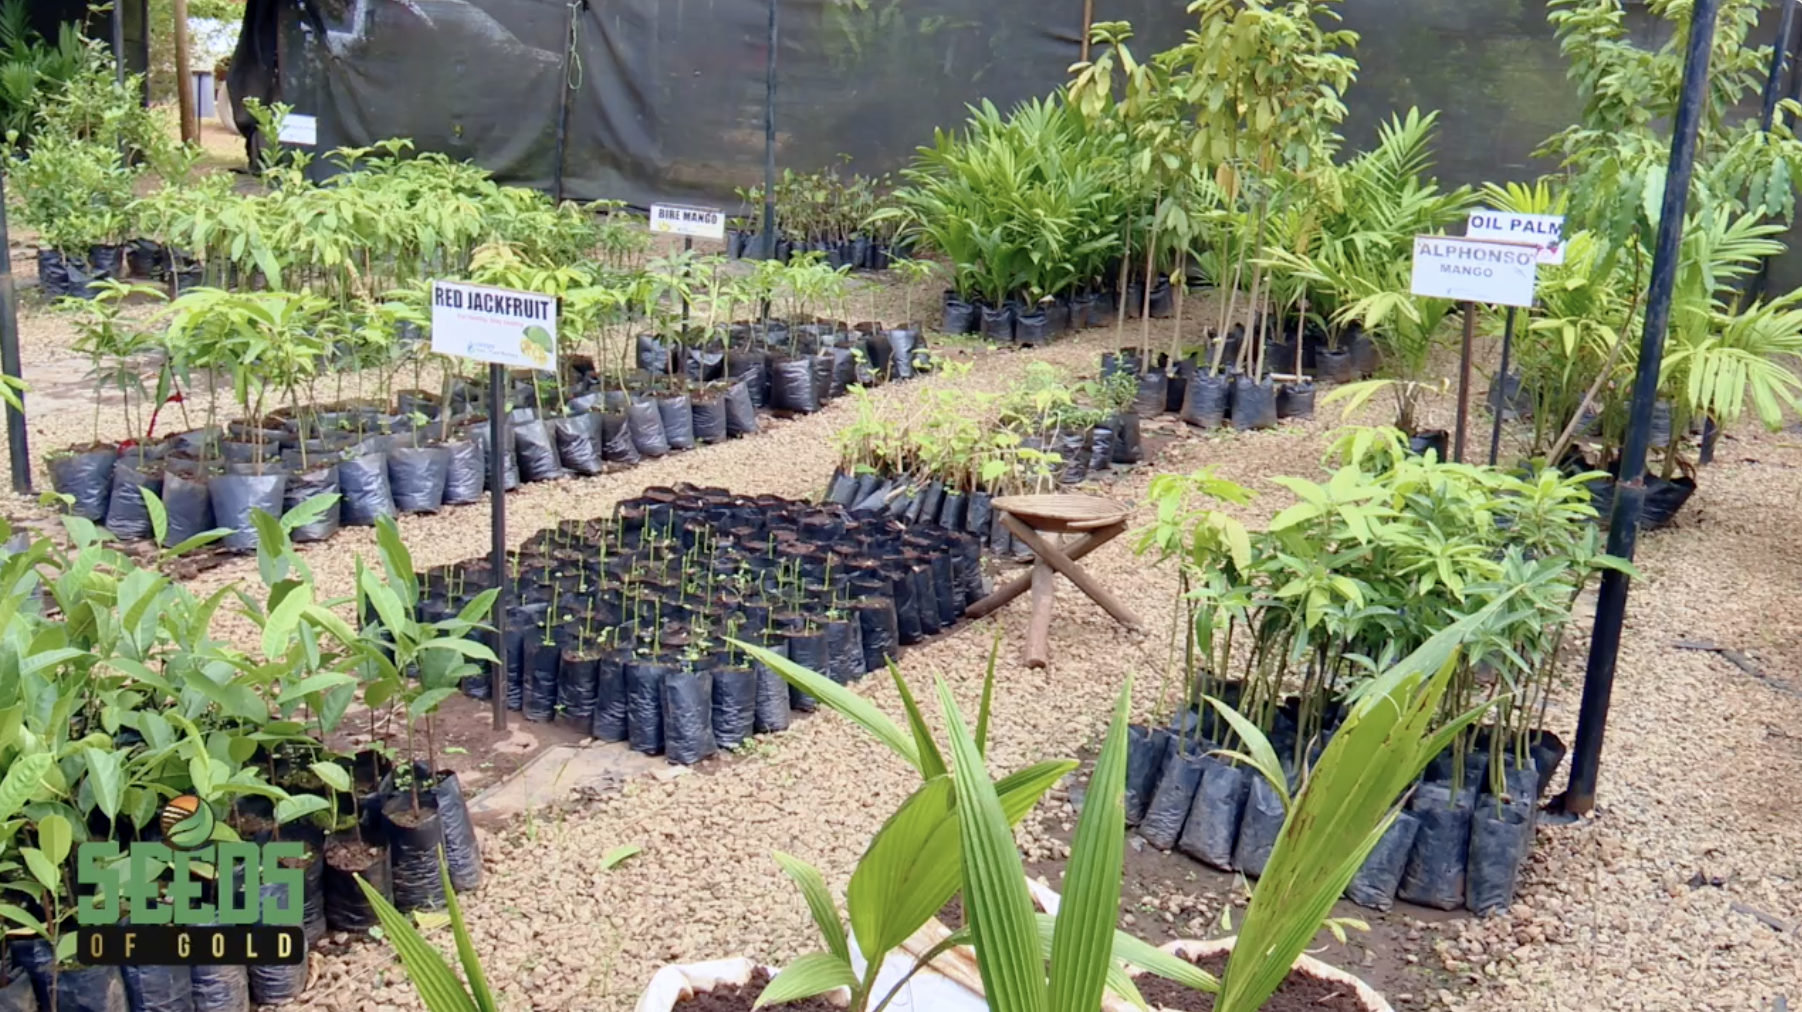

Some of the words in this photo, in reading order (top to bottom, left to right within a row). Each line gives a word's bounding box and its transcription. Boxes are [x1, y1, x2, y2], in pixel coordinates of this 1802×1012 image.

[658, 207, 680, 220] BIRE
[683, 211, 718, 224] MANGO
[1471, 215, 1502, 230] OIL
[1510, 218, 1562, 235] PALM
[1440, 264, 1493, 278] MANGO
[435, 287, 463, 309] RED
[467, 291, 549, 320] JACKFRUIT
